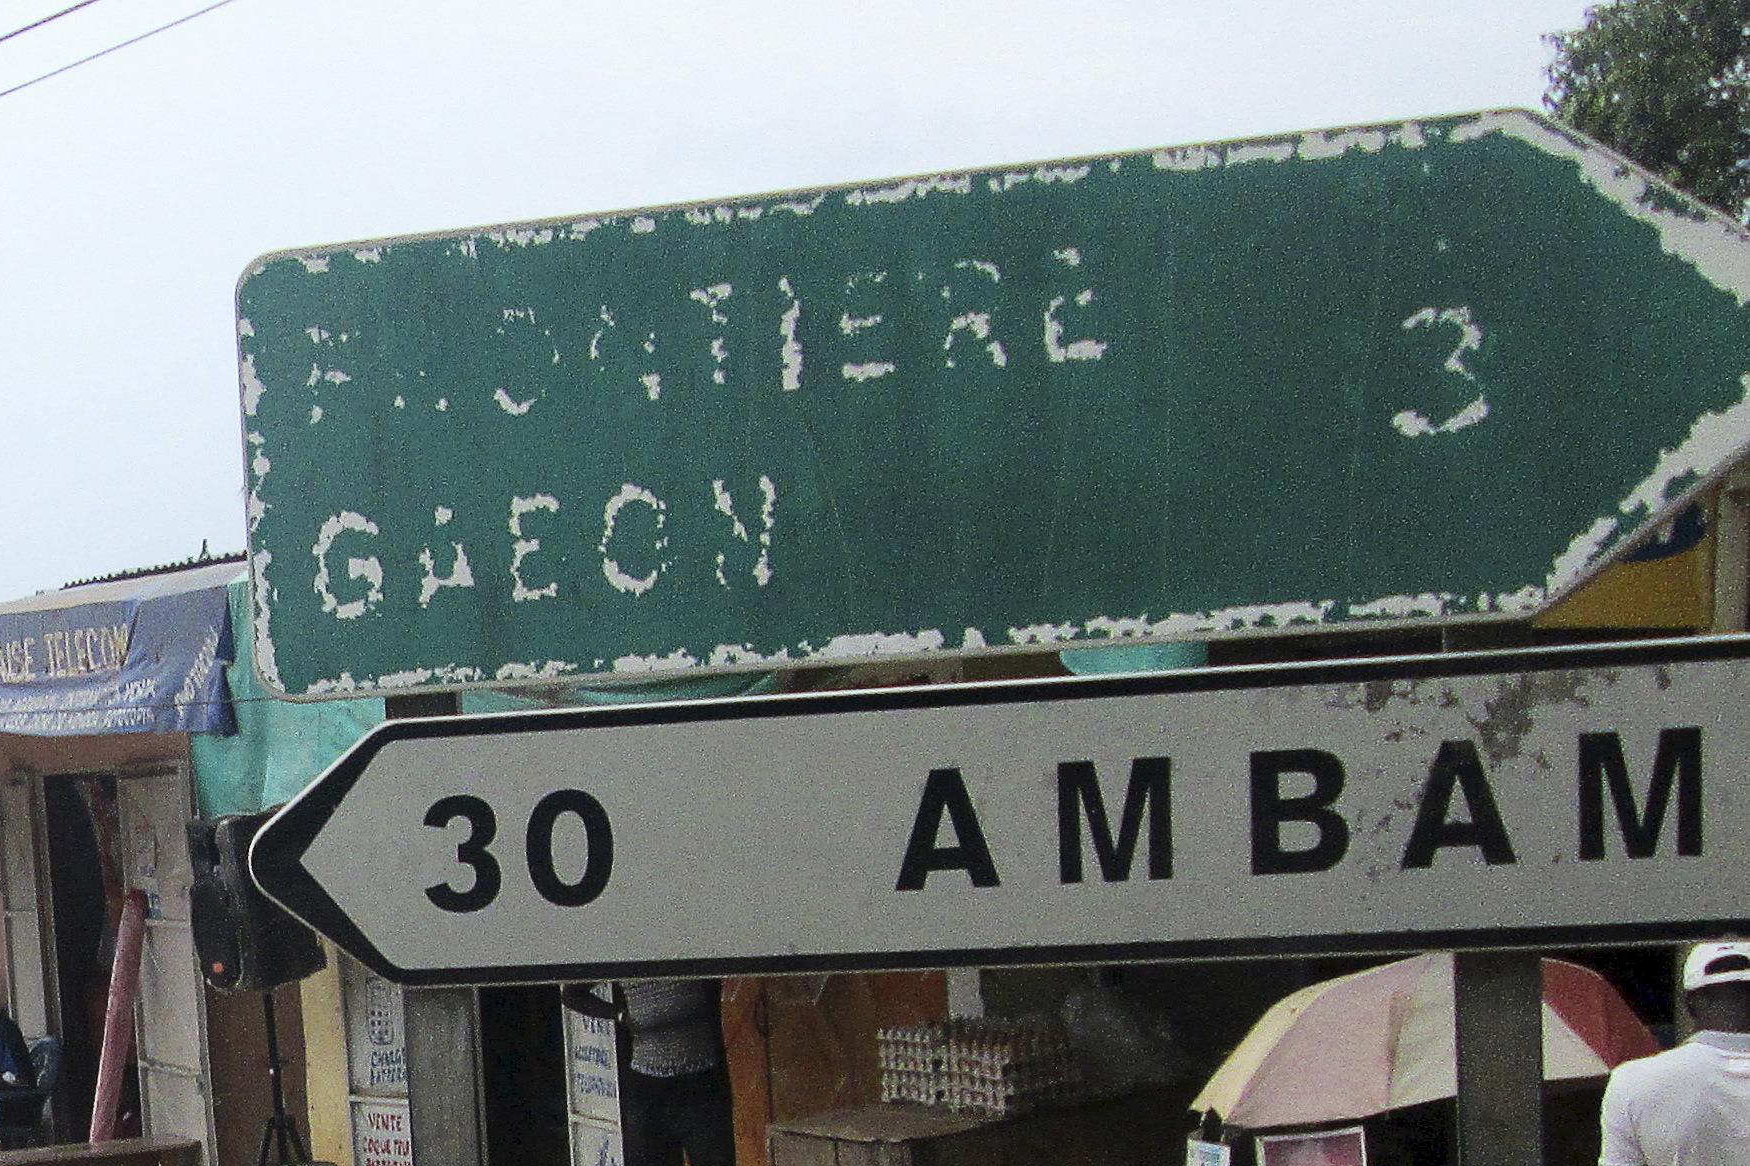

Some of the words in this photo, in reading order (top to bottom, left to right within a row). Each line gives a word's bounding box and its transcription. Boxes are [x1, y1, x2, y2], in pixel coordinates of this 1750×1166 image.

[1387, 303, 1491, 438] 3
[422, 786, 616, 915] 30
[895, 725, 1706, 894] AMBAM
